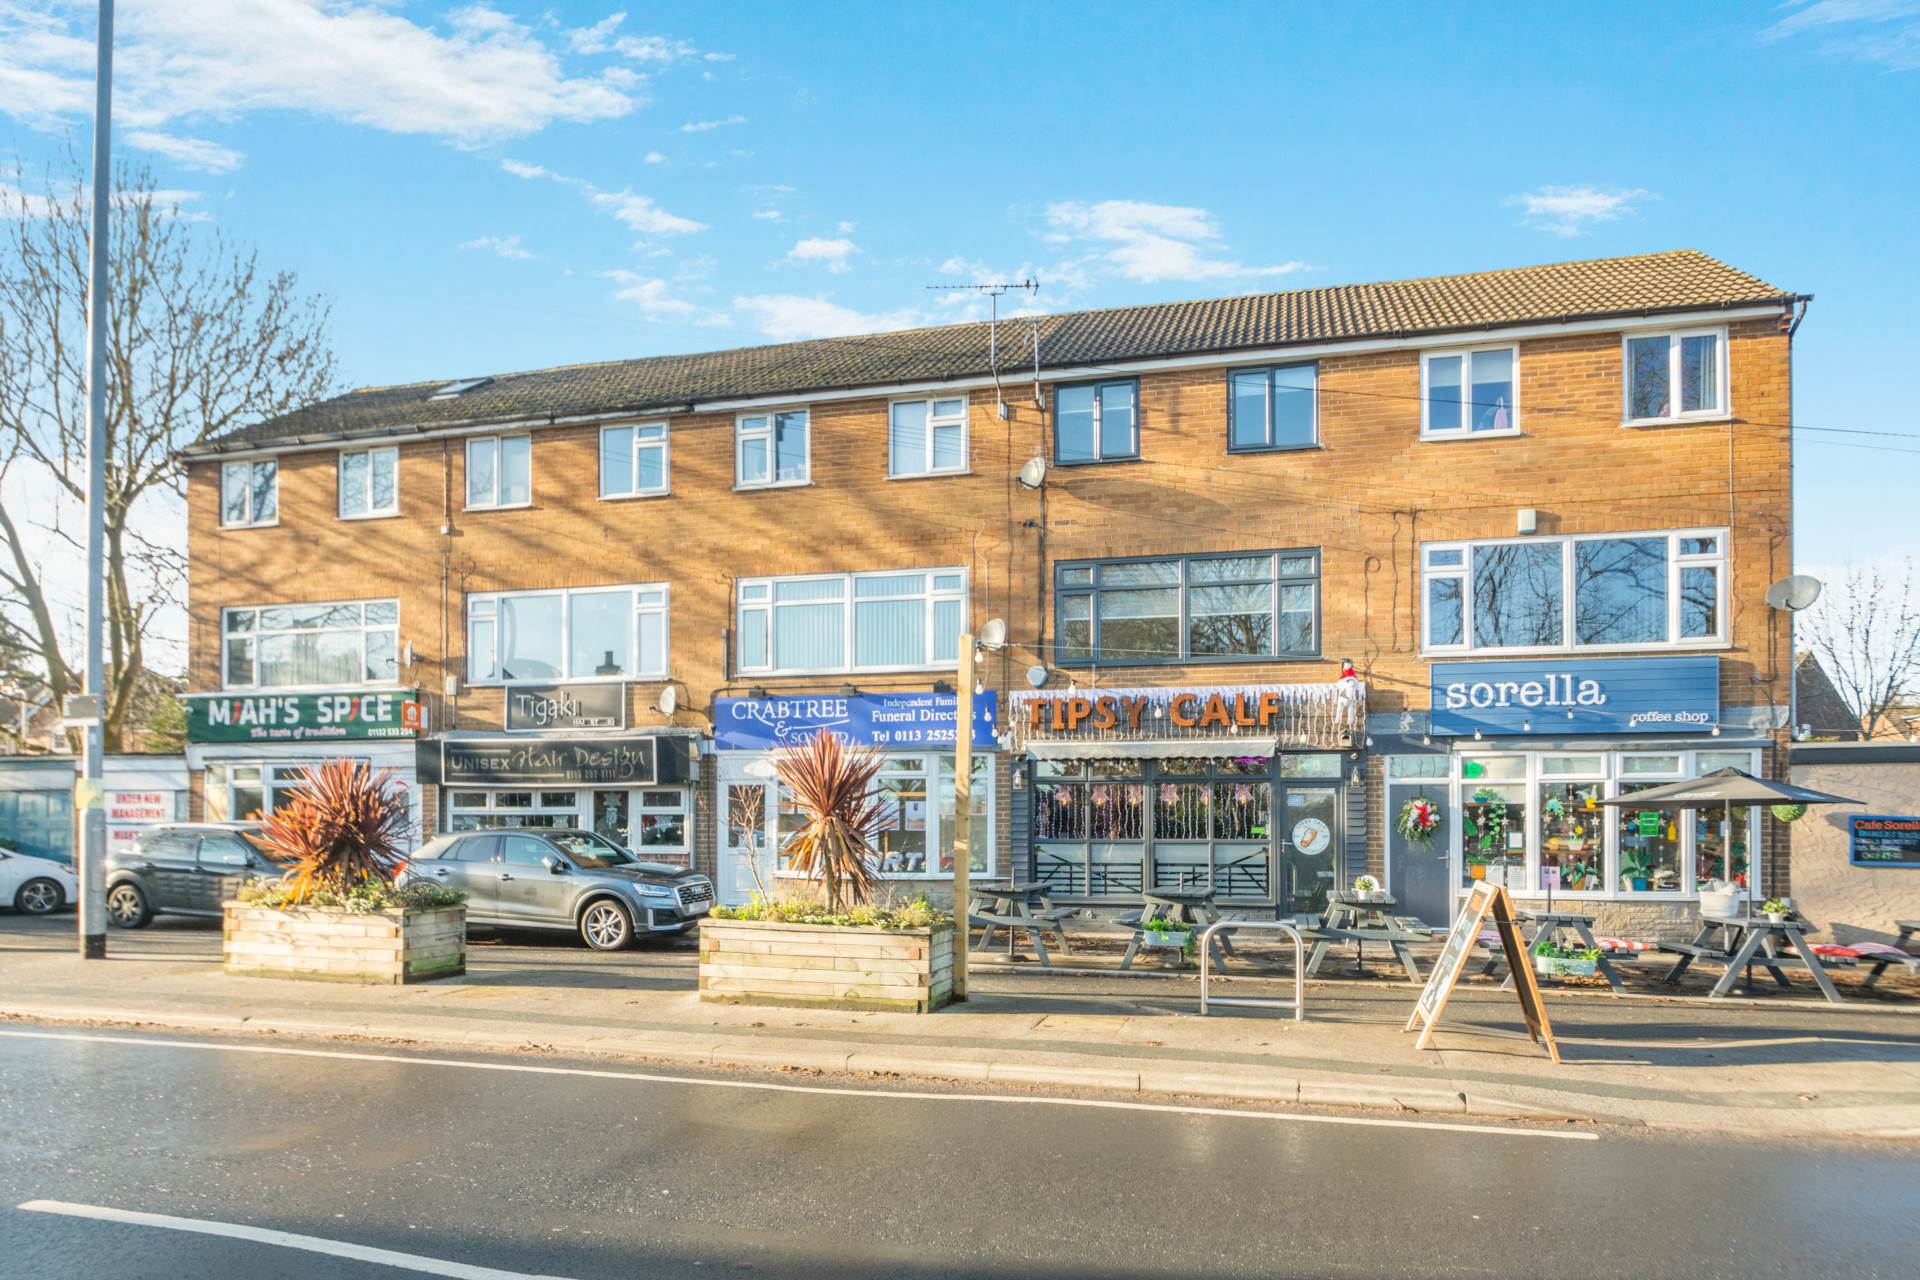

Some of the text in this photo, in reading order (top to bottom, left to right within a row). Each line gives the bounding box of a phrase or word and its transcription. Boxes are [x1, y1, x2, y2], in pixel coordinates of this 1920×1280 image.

[1446, 673, 1607, 709] sorella
[208, 694, 393, 726] MIAH'S SPICE
[515, 690, 577, 725] Tigaki
[731, 699, 849, 720] CRABTREE
[883, 696, 958, 709] Independent Fami
[871, 708, 977, 722] Funeral Directs
[1023, 692, 1280, 730] TIPSY CALF
[1631, 710, 1709, 725] coffee shop
[293, 726, 305, 740] of
[774, 720, 793, 737] &
[871, 728, 977, 742] Tel 0113 25253
[451, 755, 510, 770] UNISEX
[511, 745, 645, 778] Hair Design
[111, 808, 165, 819] MANAGEMENT
[1855, 820, 1920, 830] Cafe Sorell
